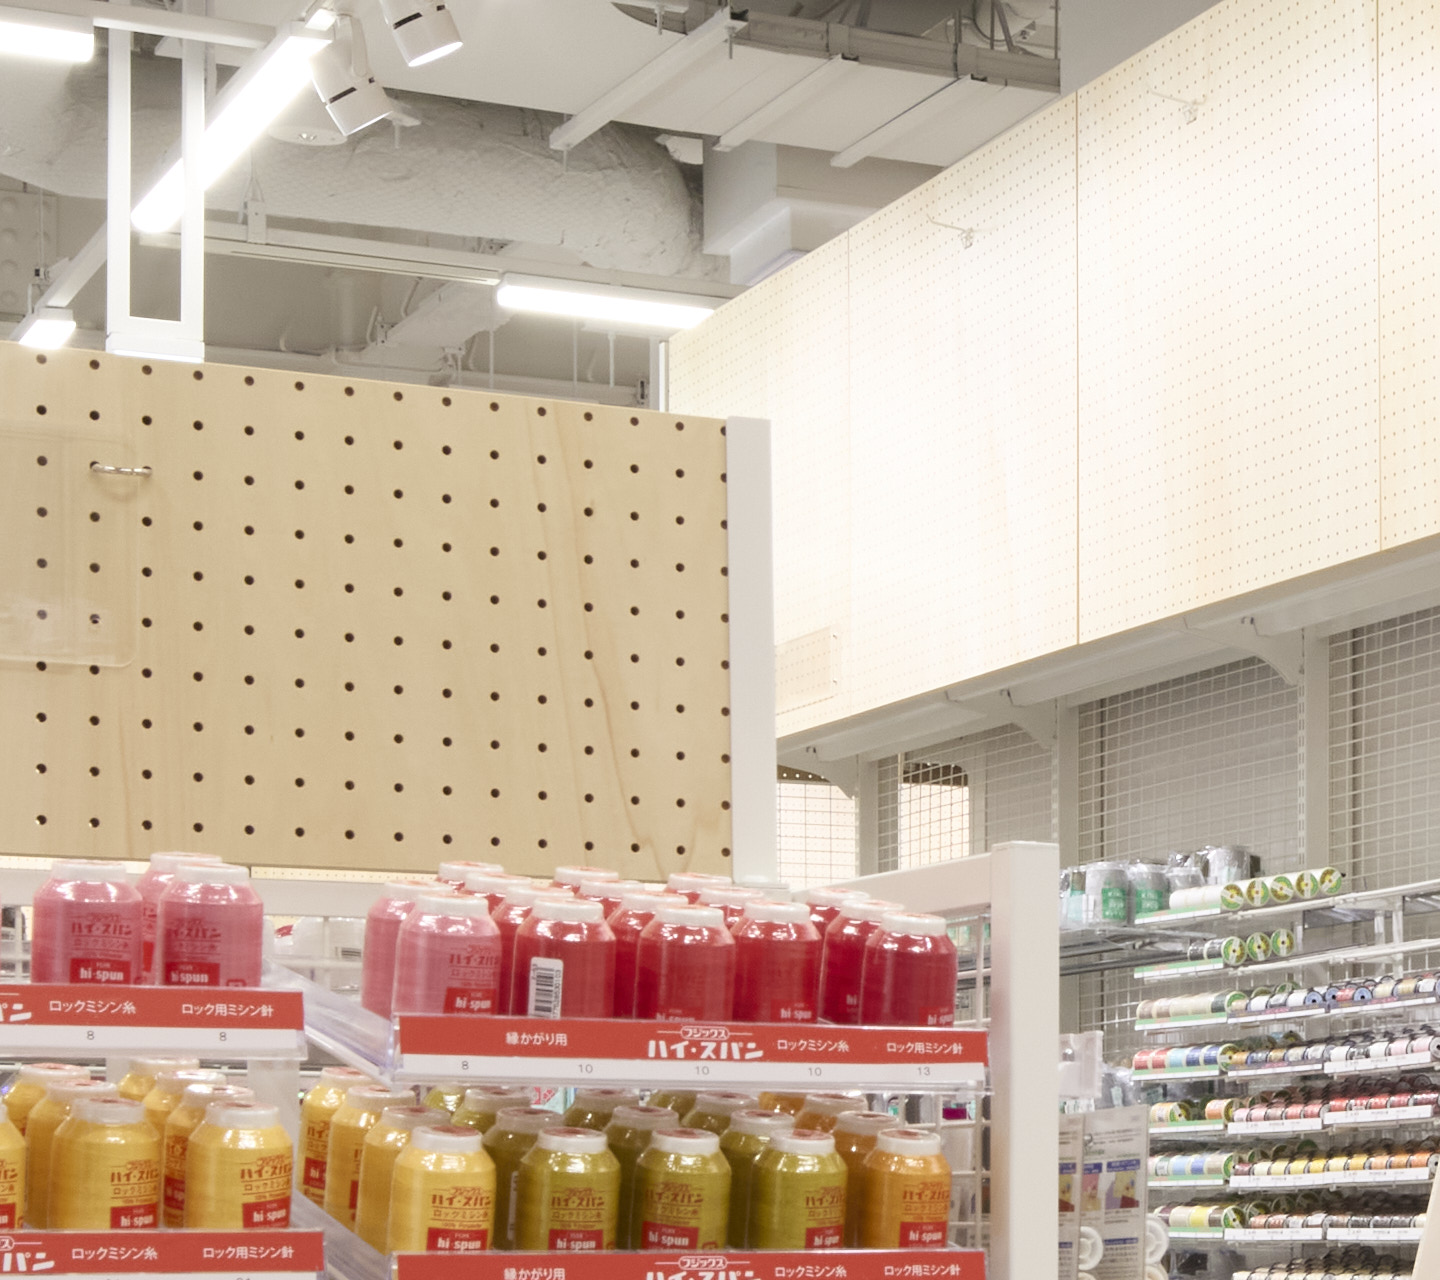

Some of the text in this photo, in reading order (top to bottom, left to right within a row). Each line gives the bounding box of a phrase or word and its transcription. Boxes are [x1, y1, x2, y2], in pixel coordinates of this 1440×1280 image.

[506, 1032, 963, 1059] 縁かがり用 ハイ・スパン ロックミシン糸 ロック用ミシン針
[462, 1061, 931, 1077] 8 10 10 13
